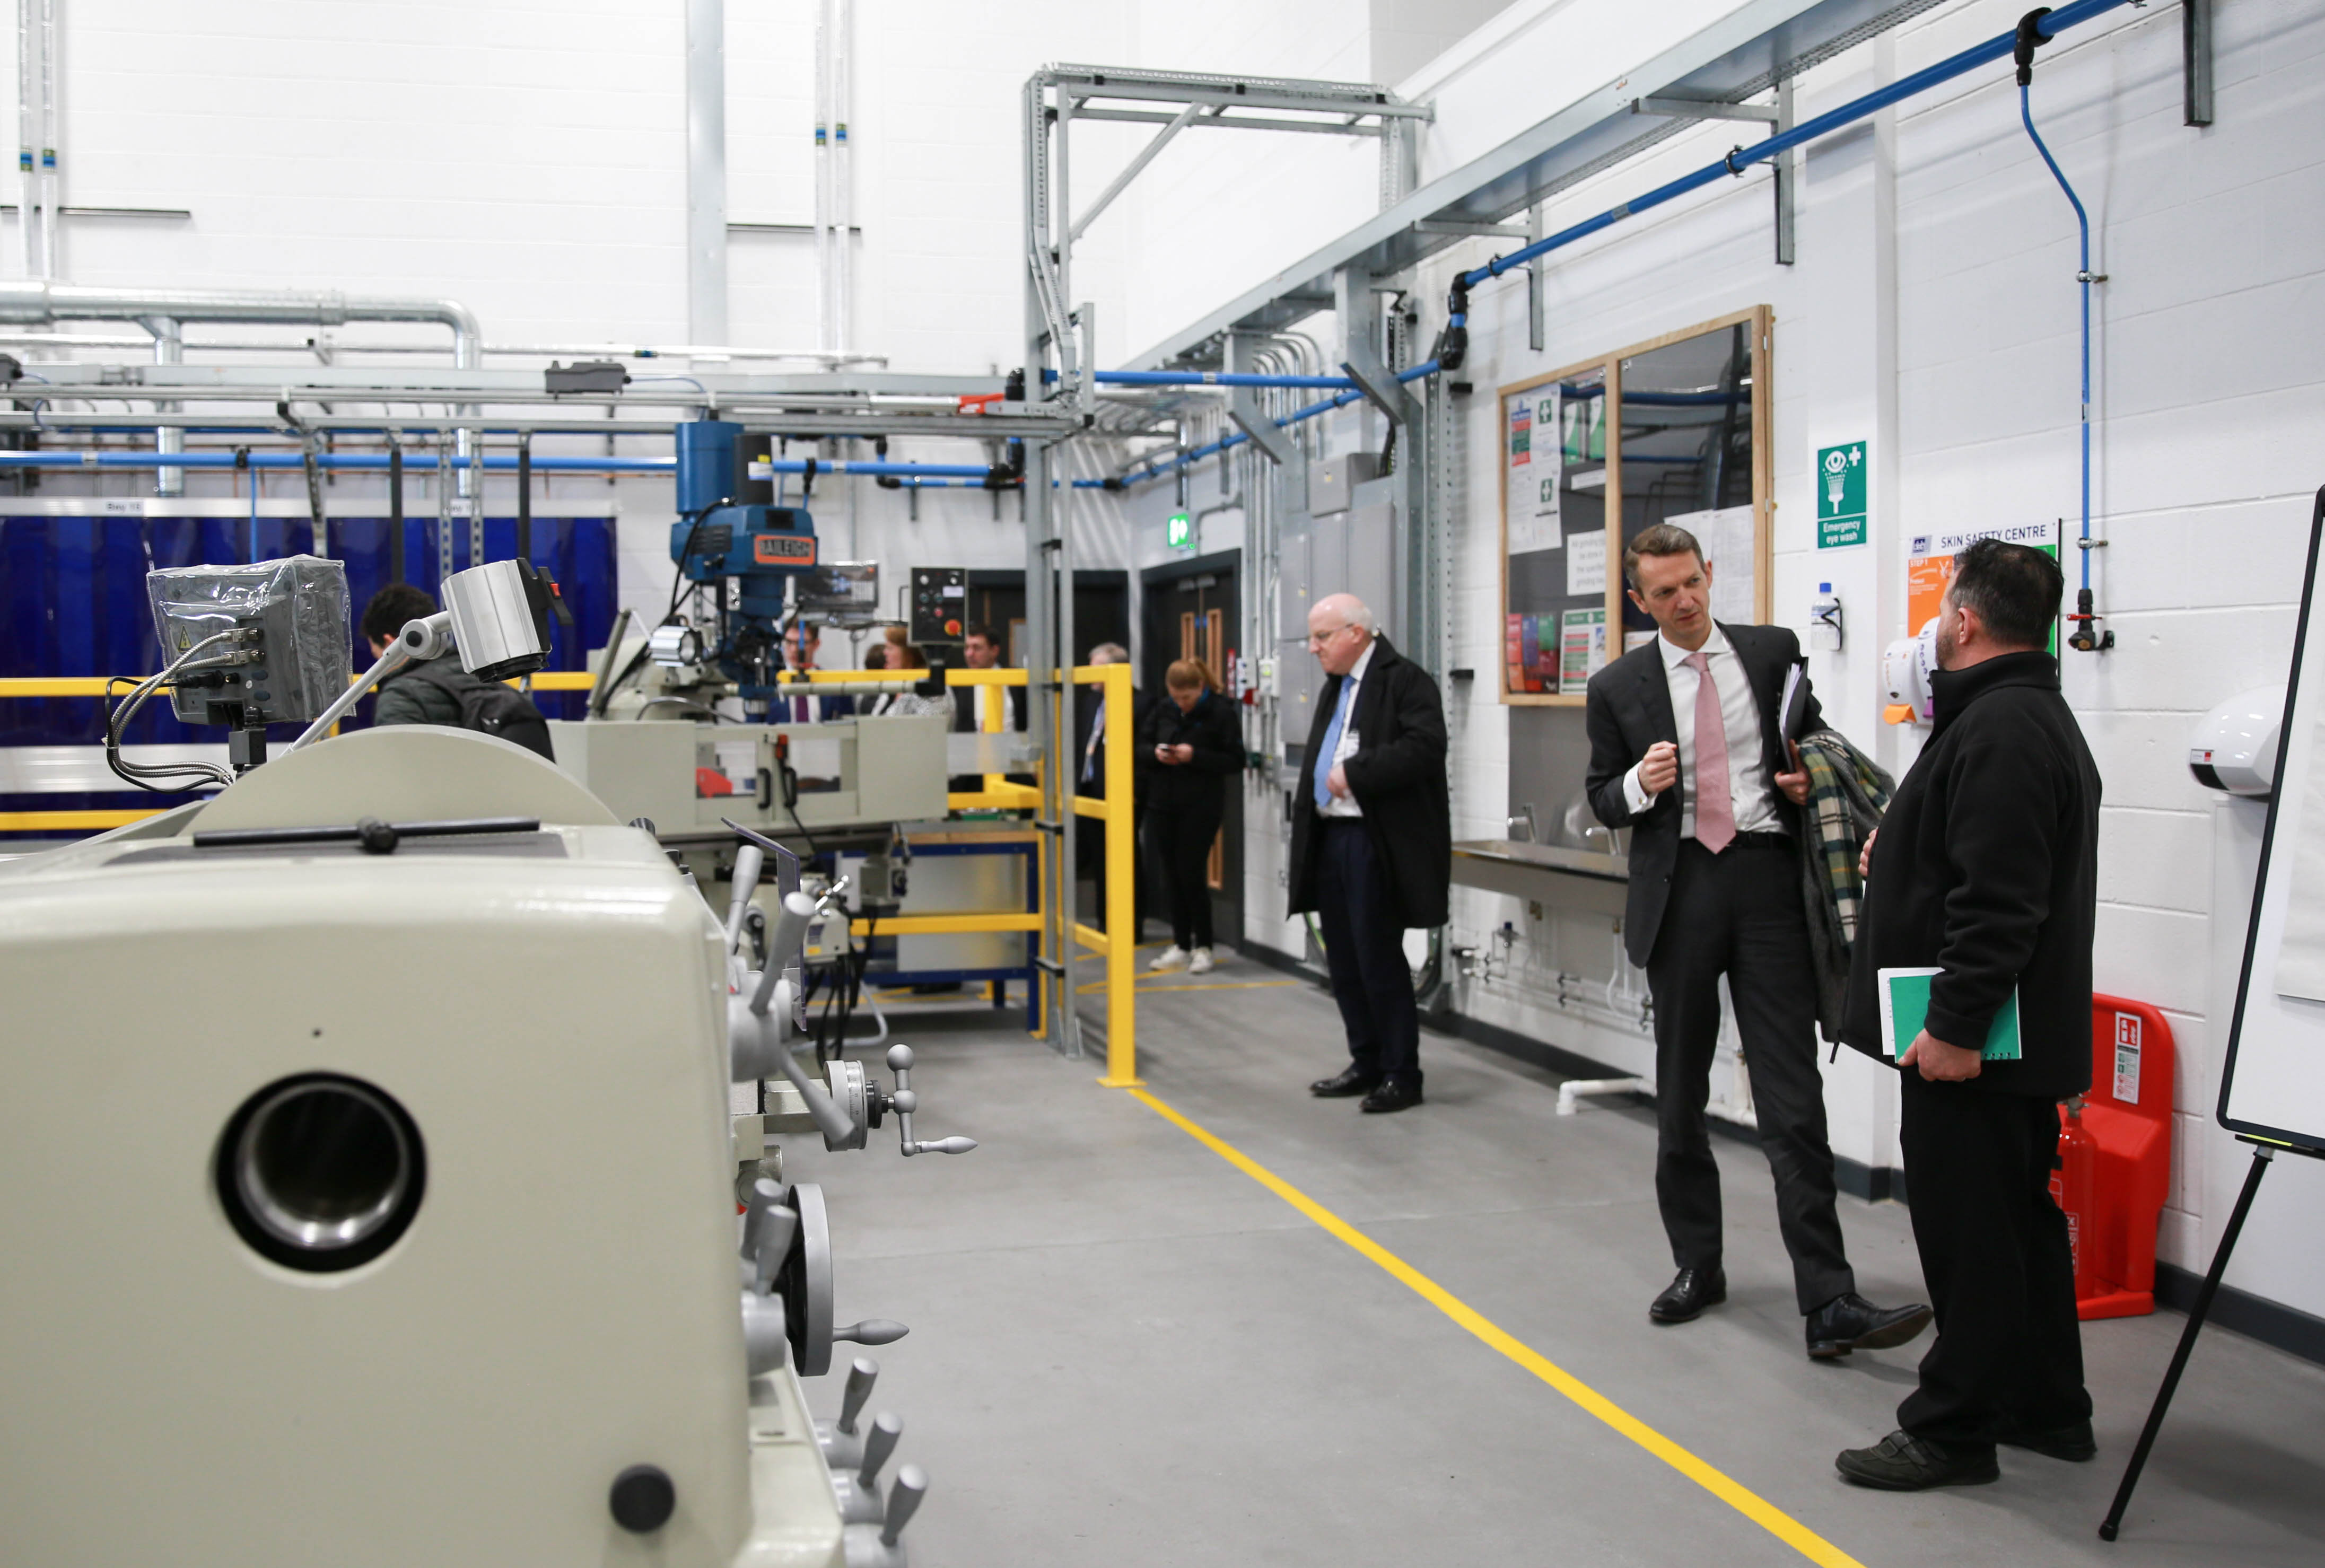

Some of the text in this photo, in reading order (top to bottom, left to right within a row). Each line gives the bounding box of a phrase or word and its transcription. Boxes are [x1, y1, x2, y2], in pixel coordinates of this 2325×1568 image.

[1823, 520, 1861, 533] Emergency
[1826, 531, 1858, 546] eye wash
[1941, 535, 1963, 548] SKIN
[2005, 524, 2047, 540] CENTRE
[758, 539, 811, 557] BAILEIGH
[1909, 559, 1923, 568] STEP
